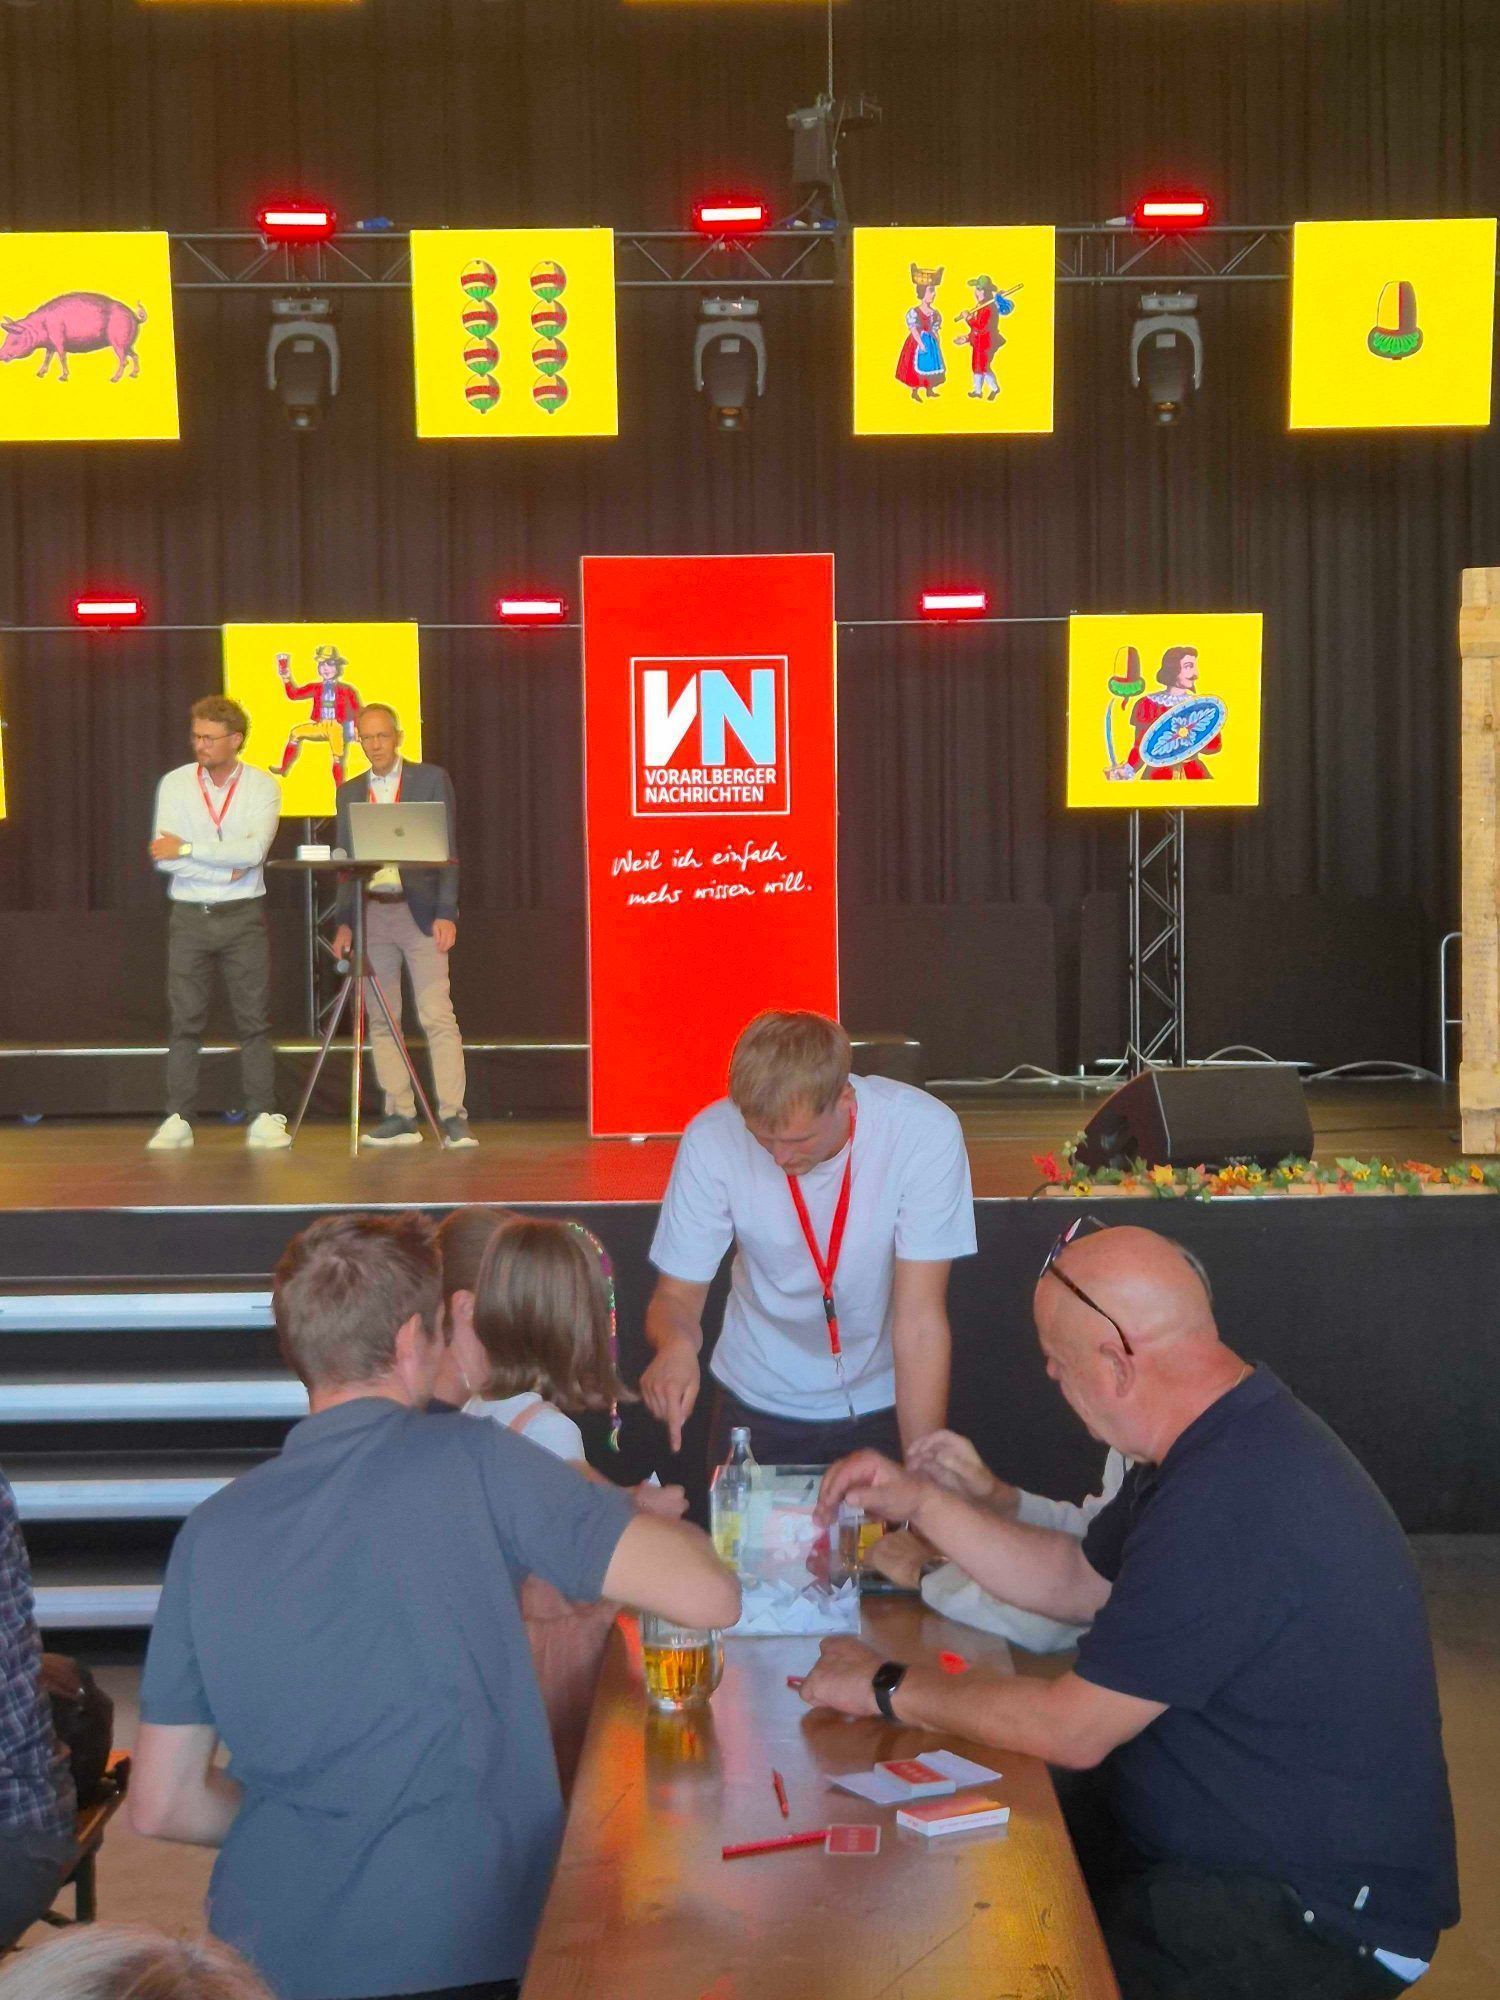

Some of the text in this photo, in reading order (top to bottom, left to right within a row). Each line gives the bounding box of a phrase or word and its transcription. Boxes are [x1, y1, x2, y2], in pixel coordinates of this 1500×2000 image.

[645, 768, 776, 785] VORARLBERGER
[645, 786, 764, 803] NACHRICHTEN
[612, 840, 787, 876] Weil ich einfach
[627, 870, 812, 906] mehr wissen will.
